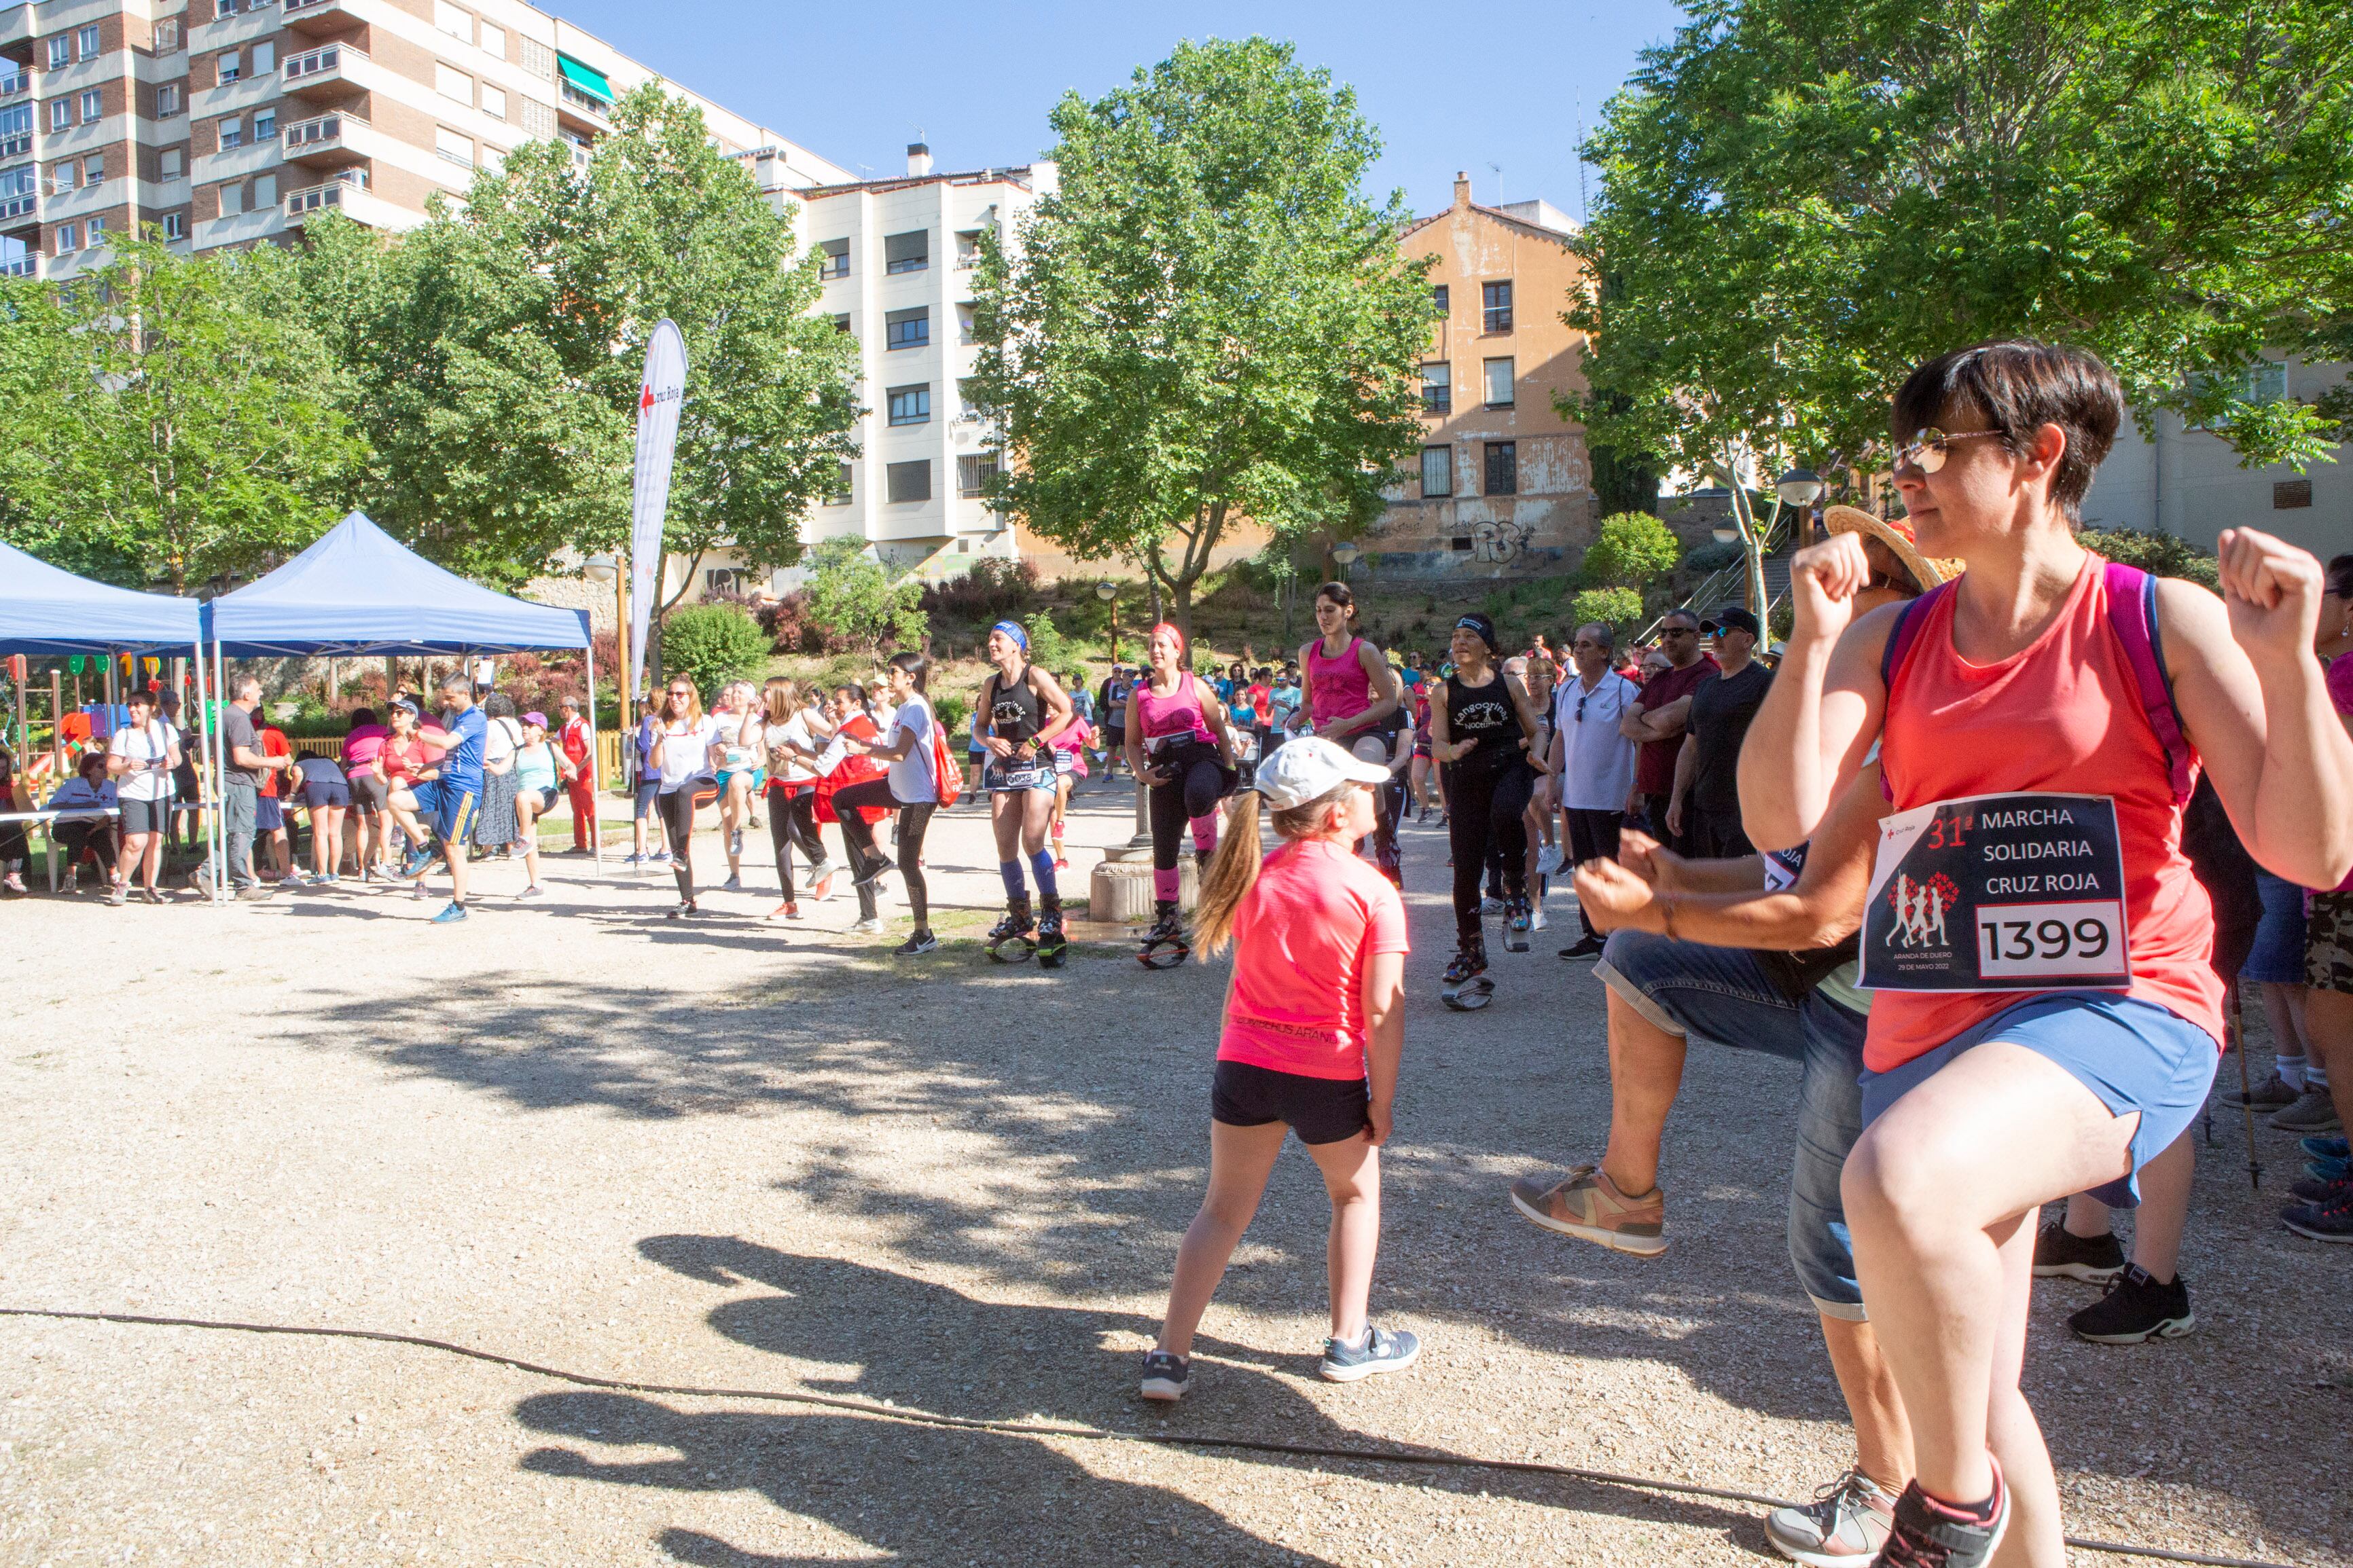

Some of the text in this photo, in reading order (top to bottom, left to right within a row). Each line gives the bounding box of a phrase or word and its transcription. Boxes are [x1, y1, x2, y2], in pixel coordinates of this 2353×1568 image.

[667, 384, 679, 403] Roja
[991, 701, 1026, 718] angoorinas
[1981, 809, 2074, 829] MARCHA
[1779, 847, 1802, 867] OJA
[1983, 840, 2094, 862] SOLIDARIA
[1986, 873, 2100, 894] CRUZ ROJA
[1981, 918, 2109, 960] 1399
